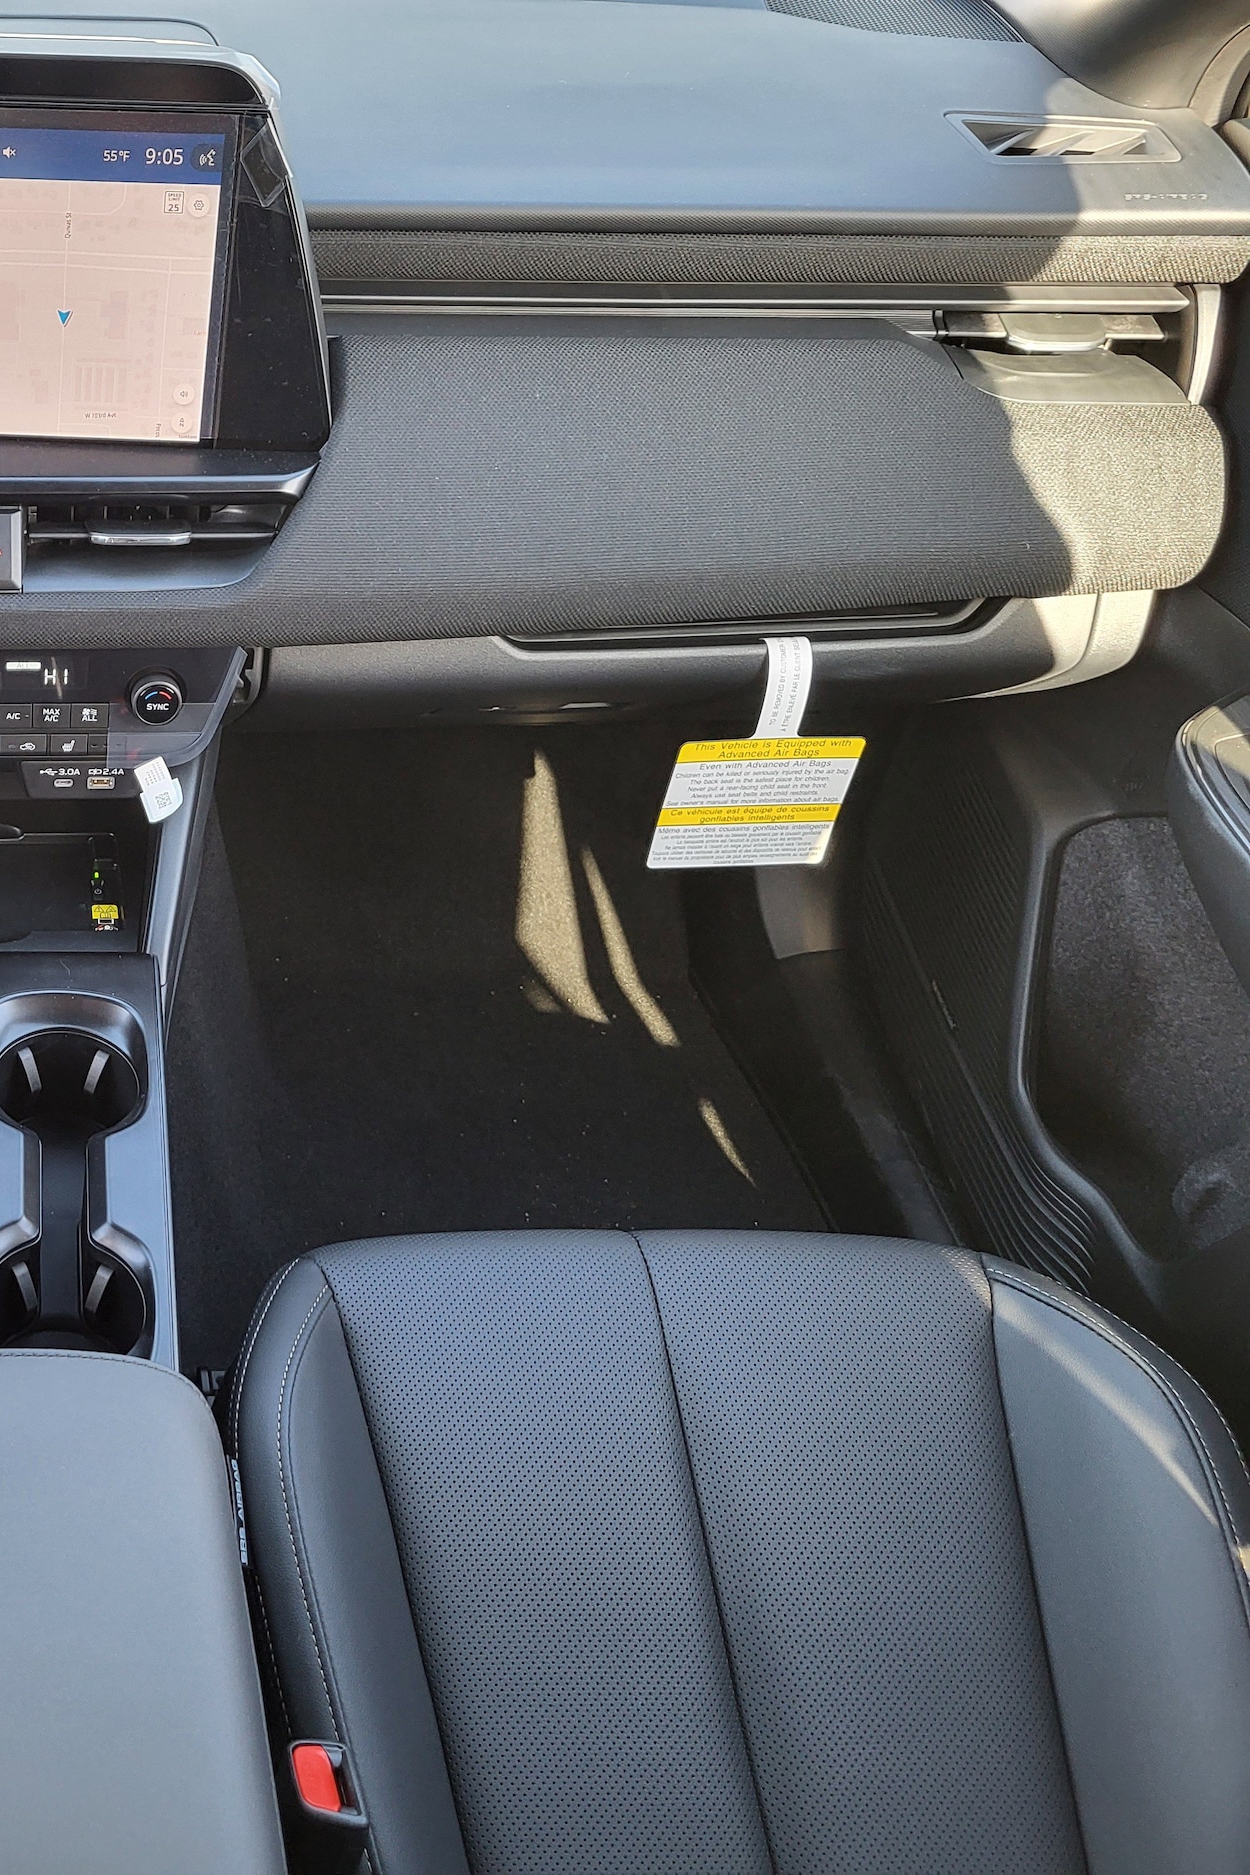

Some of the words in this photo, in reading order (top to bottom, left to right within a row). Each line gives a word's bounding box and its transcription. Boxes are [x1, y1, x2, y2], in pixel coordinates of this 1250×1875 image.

[103, 150, 130, 163] 55°F
[145, 148, 184, 166] 9:05
[168, 203, 179, 212] 25
[146, 703, 169, 711] SYNC
[6, 712, 21, 720] A/C
[42, 708, 60, 716] MAX
[81, 714, 98, 722] ALL
[721, 741, 758, 750] Vehicle
[776, 739, 826, 748] Equipped
[718, 750, 770, 759] Advanced
[774, 749, 789, 757] Air
[794, 748, 820, 758] Bags
[746, 760, 790, 768] Advanced
[809, 760, 831, 768] Bags
[58, 768, 81, 776] 3.0A
[102, 768, 124, 776] 2.4A
[700, 816, 744, 824] gonflables
[748, 814, 795, 822] intelligents
[752, 824, 789, 832] gonflables
